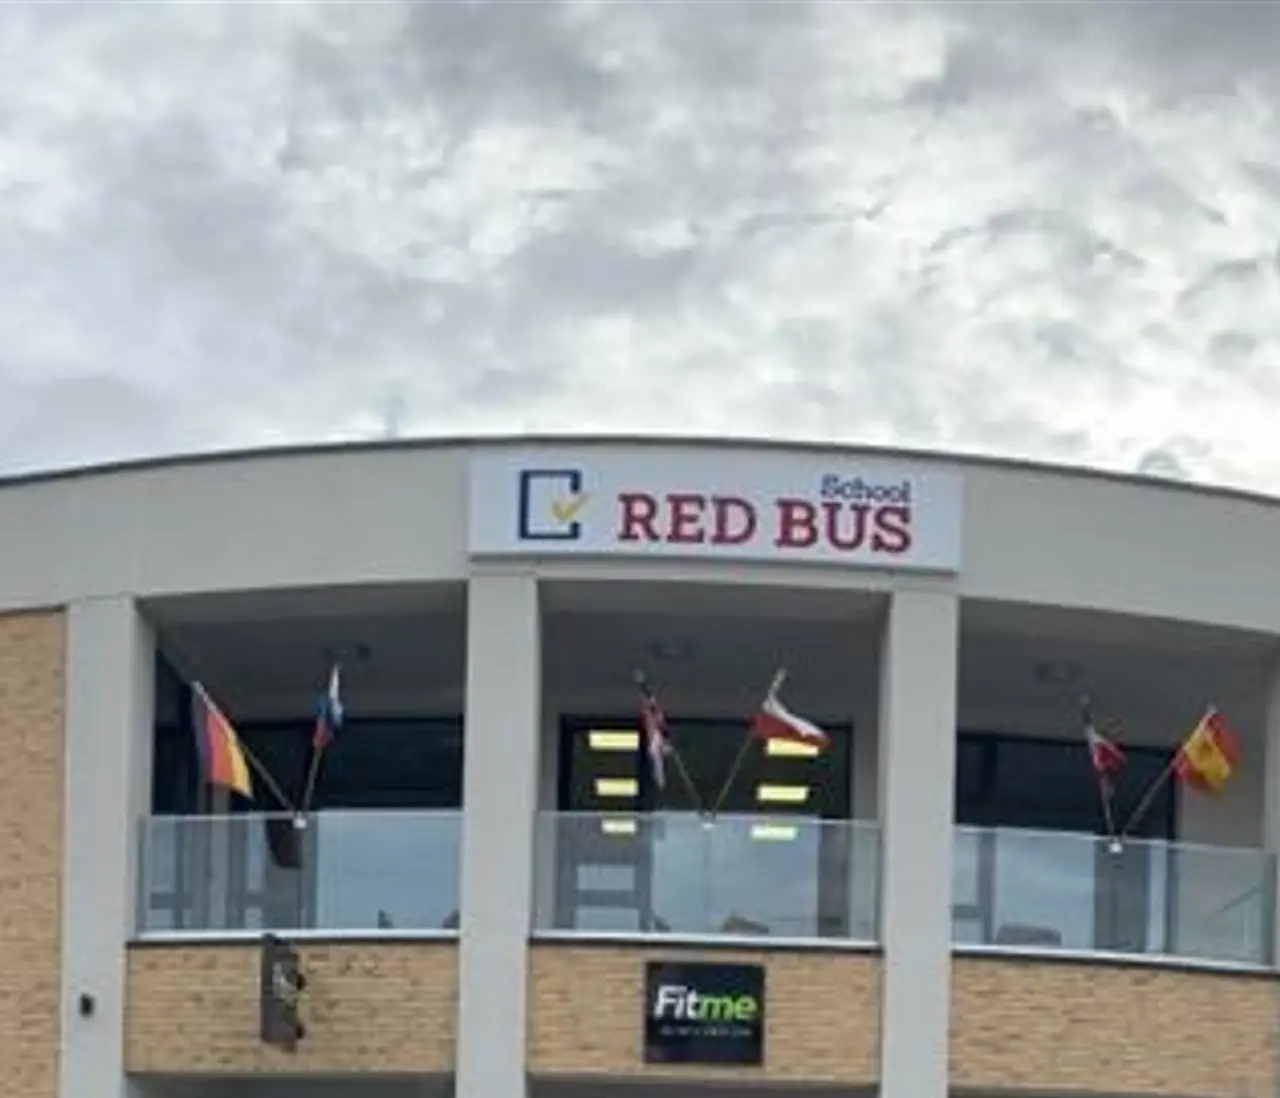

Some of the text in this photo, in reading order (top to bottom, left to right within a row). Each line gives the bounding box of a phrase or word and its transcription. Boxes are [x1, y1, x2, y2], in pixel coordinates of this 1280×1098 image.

[821, 475, 911, 501] School
[617, 493, 912, 553] RED BUS
[653, 984, 758, 1020] Fitme
